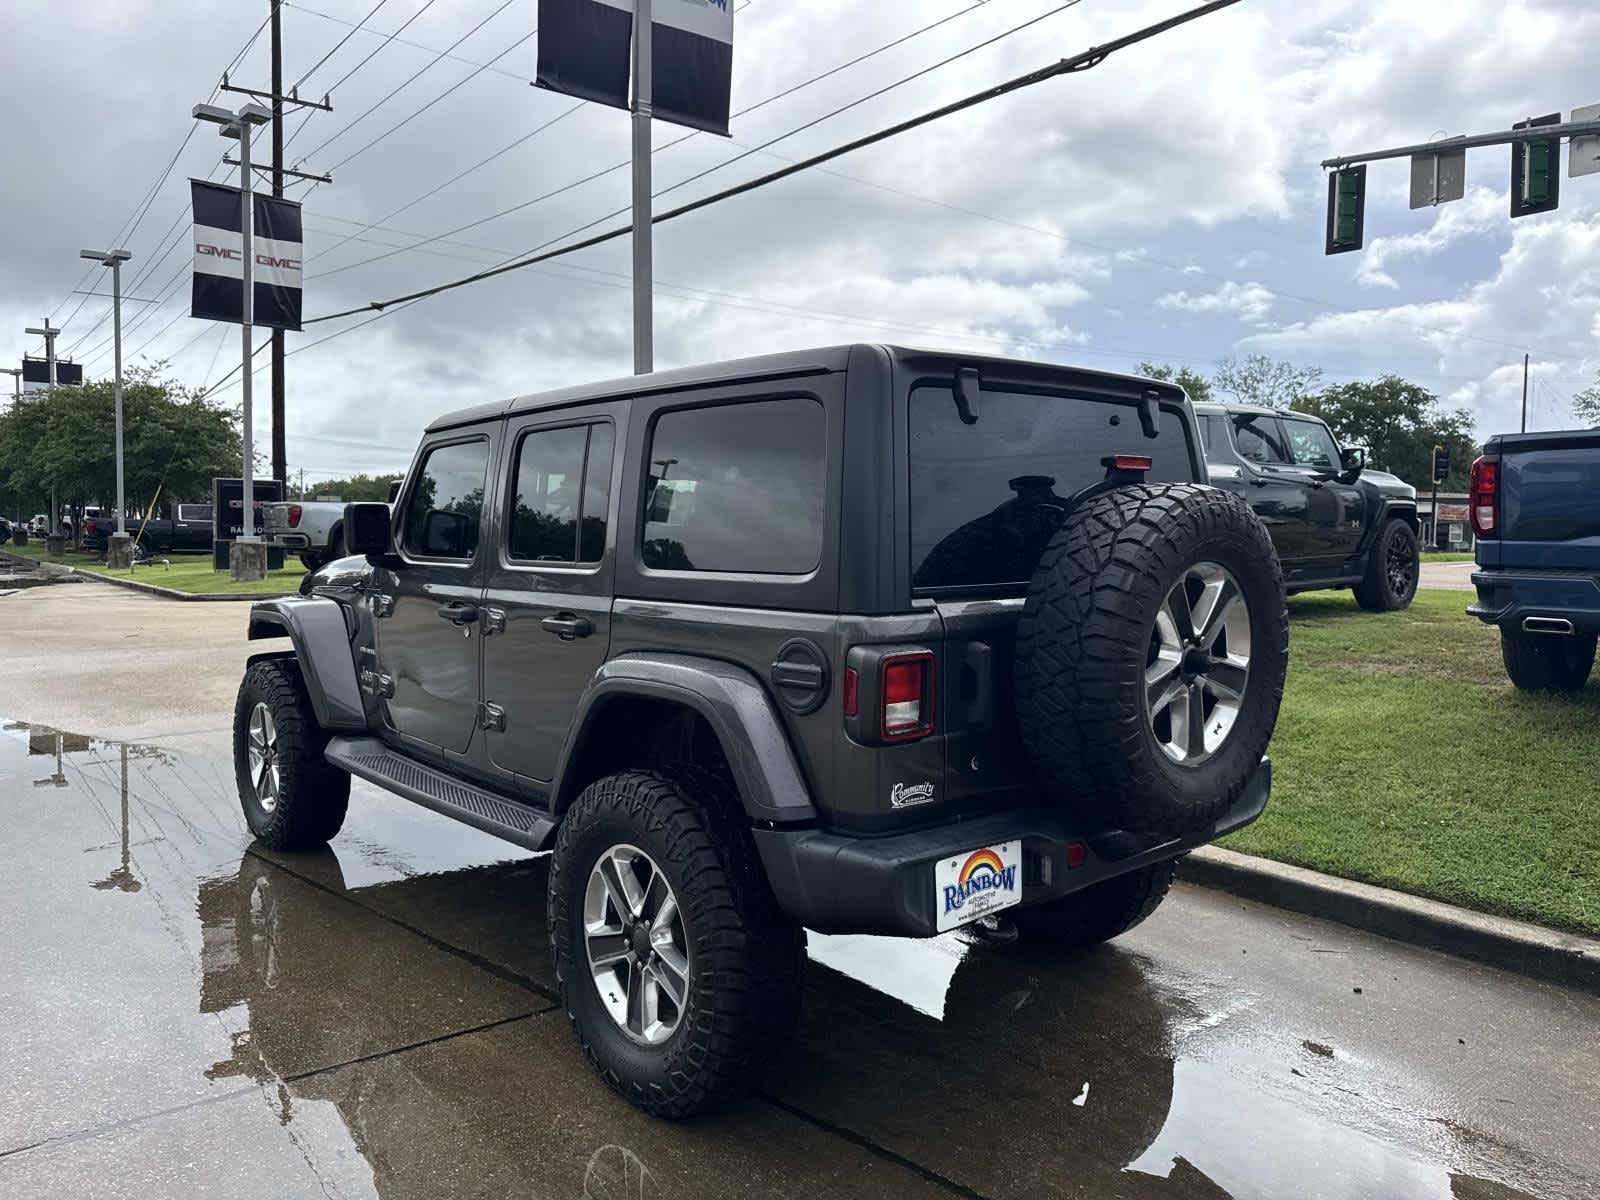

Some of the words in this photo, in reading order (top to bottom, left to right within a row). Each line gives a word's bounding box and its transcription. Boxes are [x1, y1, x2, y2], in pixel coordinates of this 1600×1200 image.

[196, 243, 242, 261] GMC
[255, 254, 302, 270] GMC
[890, 782, 934, 807] Community
[943, 864, 1018, 914] RAINBOW
